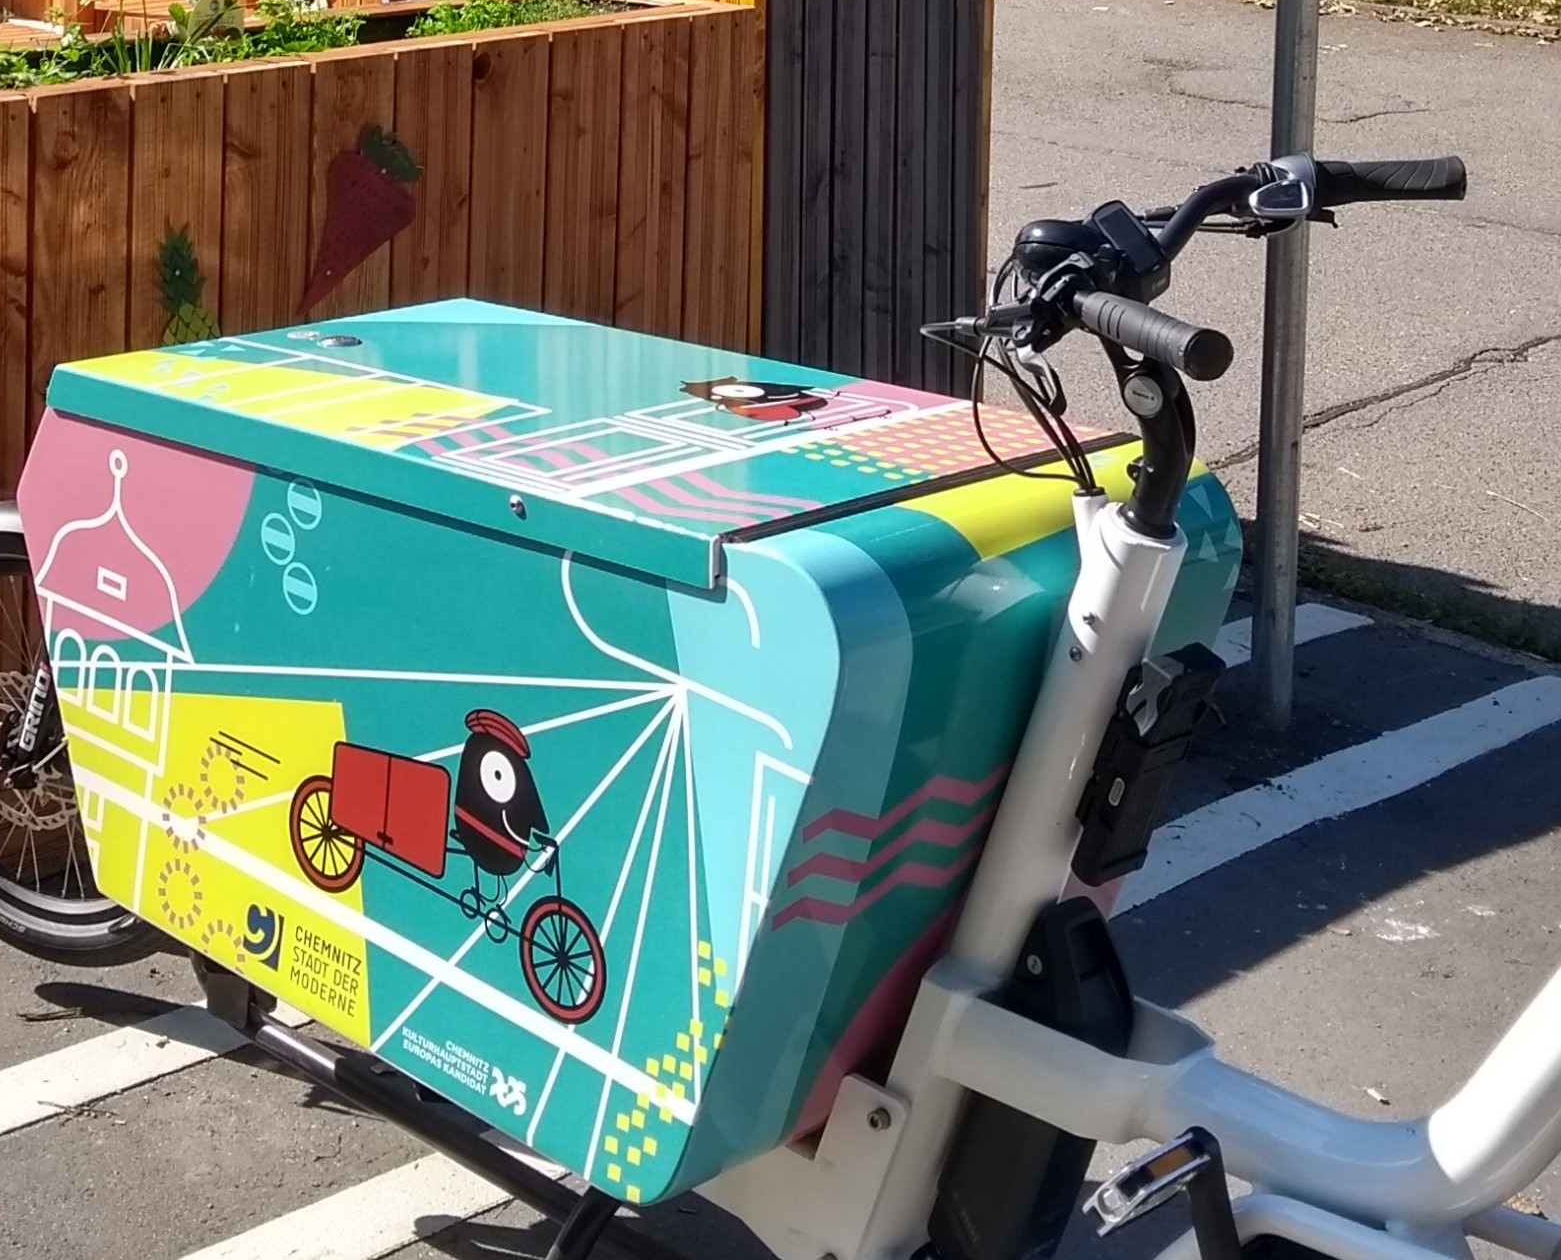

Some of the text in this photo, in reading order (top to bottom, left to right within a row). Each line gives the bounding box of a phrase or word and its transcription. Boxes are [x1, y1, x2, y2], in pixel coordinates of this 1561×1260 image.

[292, 946, 359, 996] STADT DER
[295, 925, 362, 976] CHEMNITZ
[290, 966, 356, 1017] MODERNE
[402, 1026, 488, 1084] KULTURHAUPTSTADT
[402, 1039, 487, 1095] EUROPAS KANDIDAT
[445, 1040, 490, 1074] CHEMNITZ
